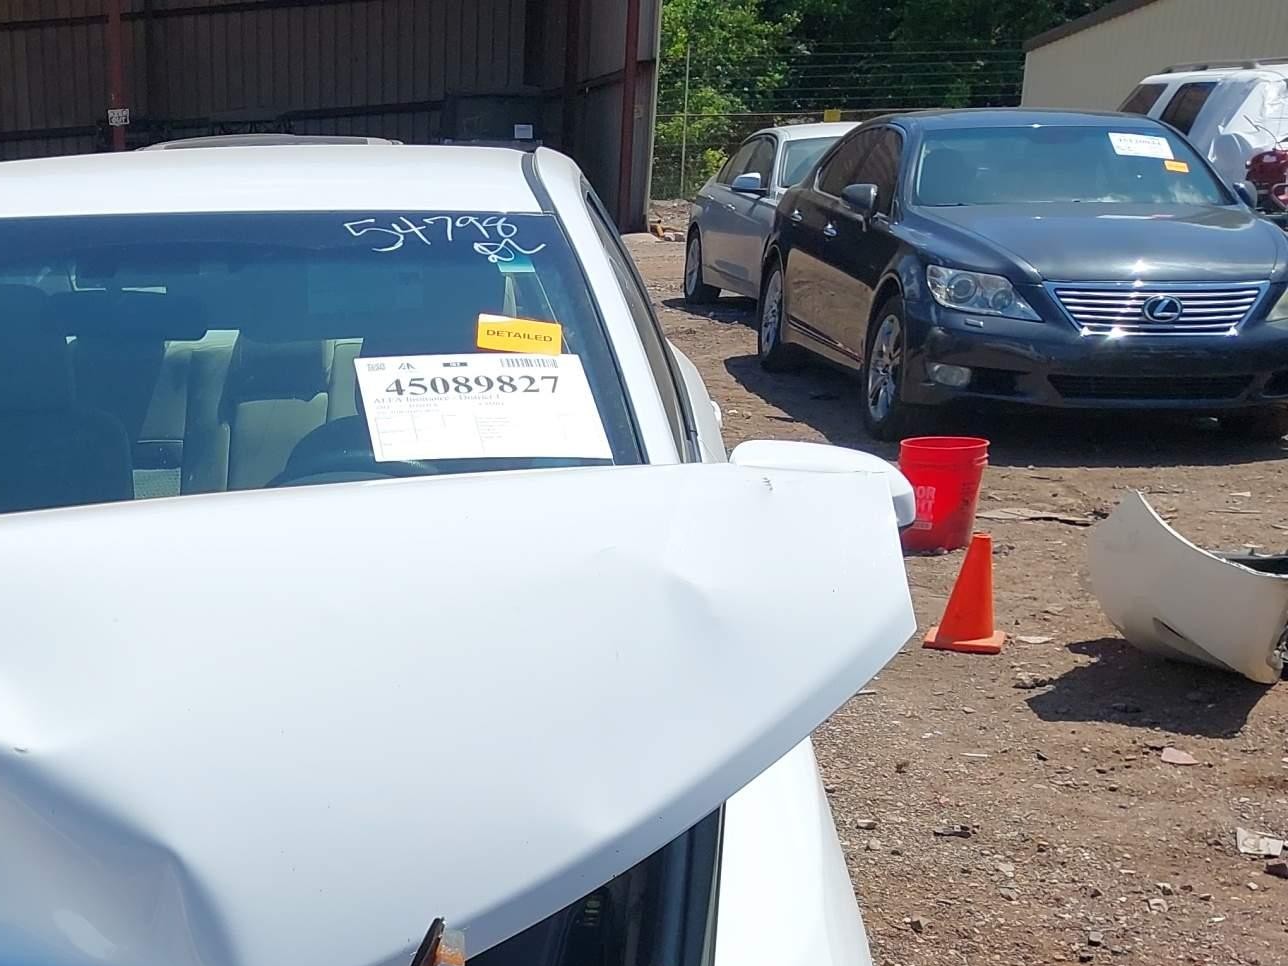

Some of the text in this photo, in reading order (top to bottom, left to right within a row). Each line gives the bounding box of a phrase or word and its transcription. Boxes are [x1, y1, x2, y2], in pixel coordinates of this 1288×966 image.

[344, 215, 517, 251] 54798
[486, 329, 553, 342] DETAILED
[385, 375, 559, 396] 45089827
